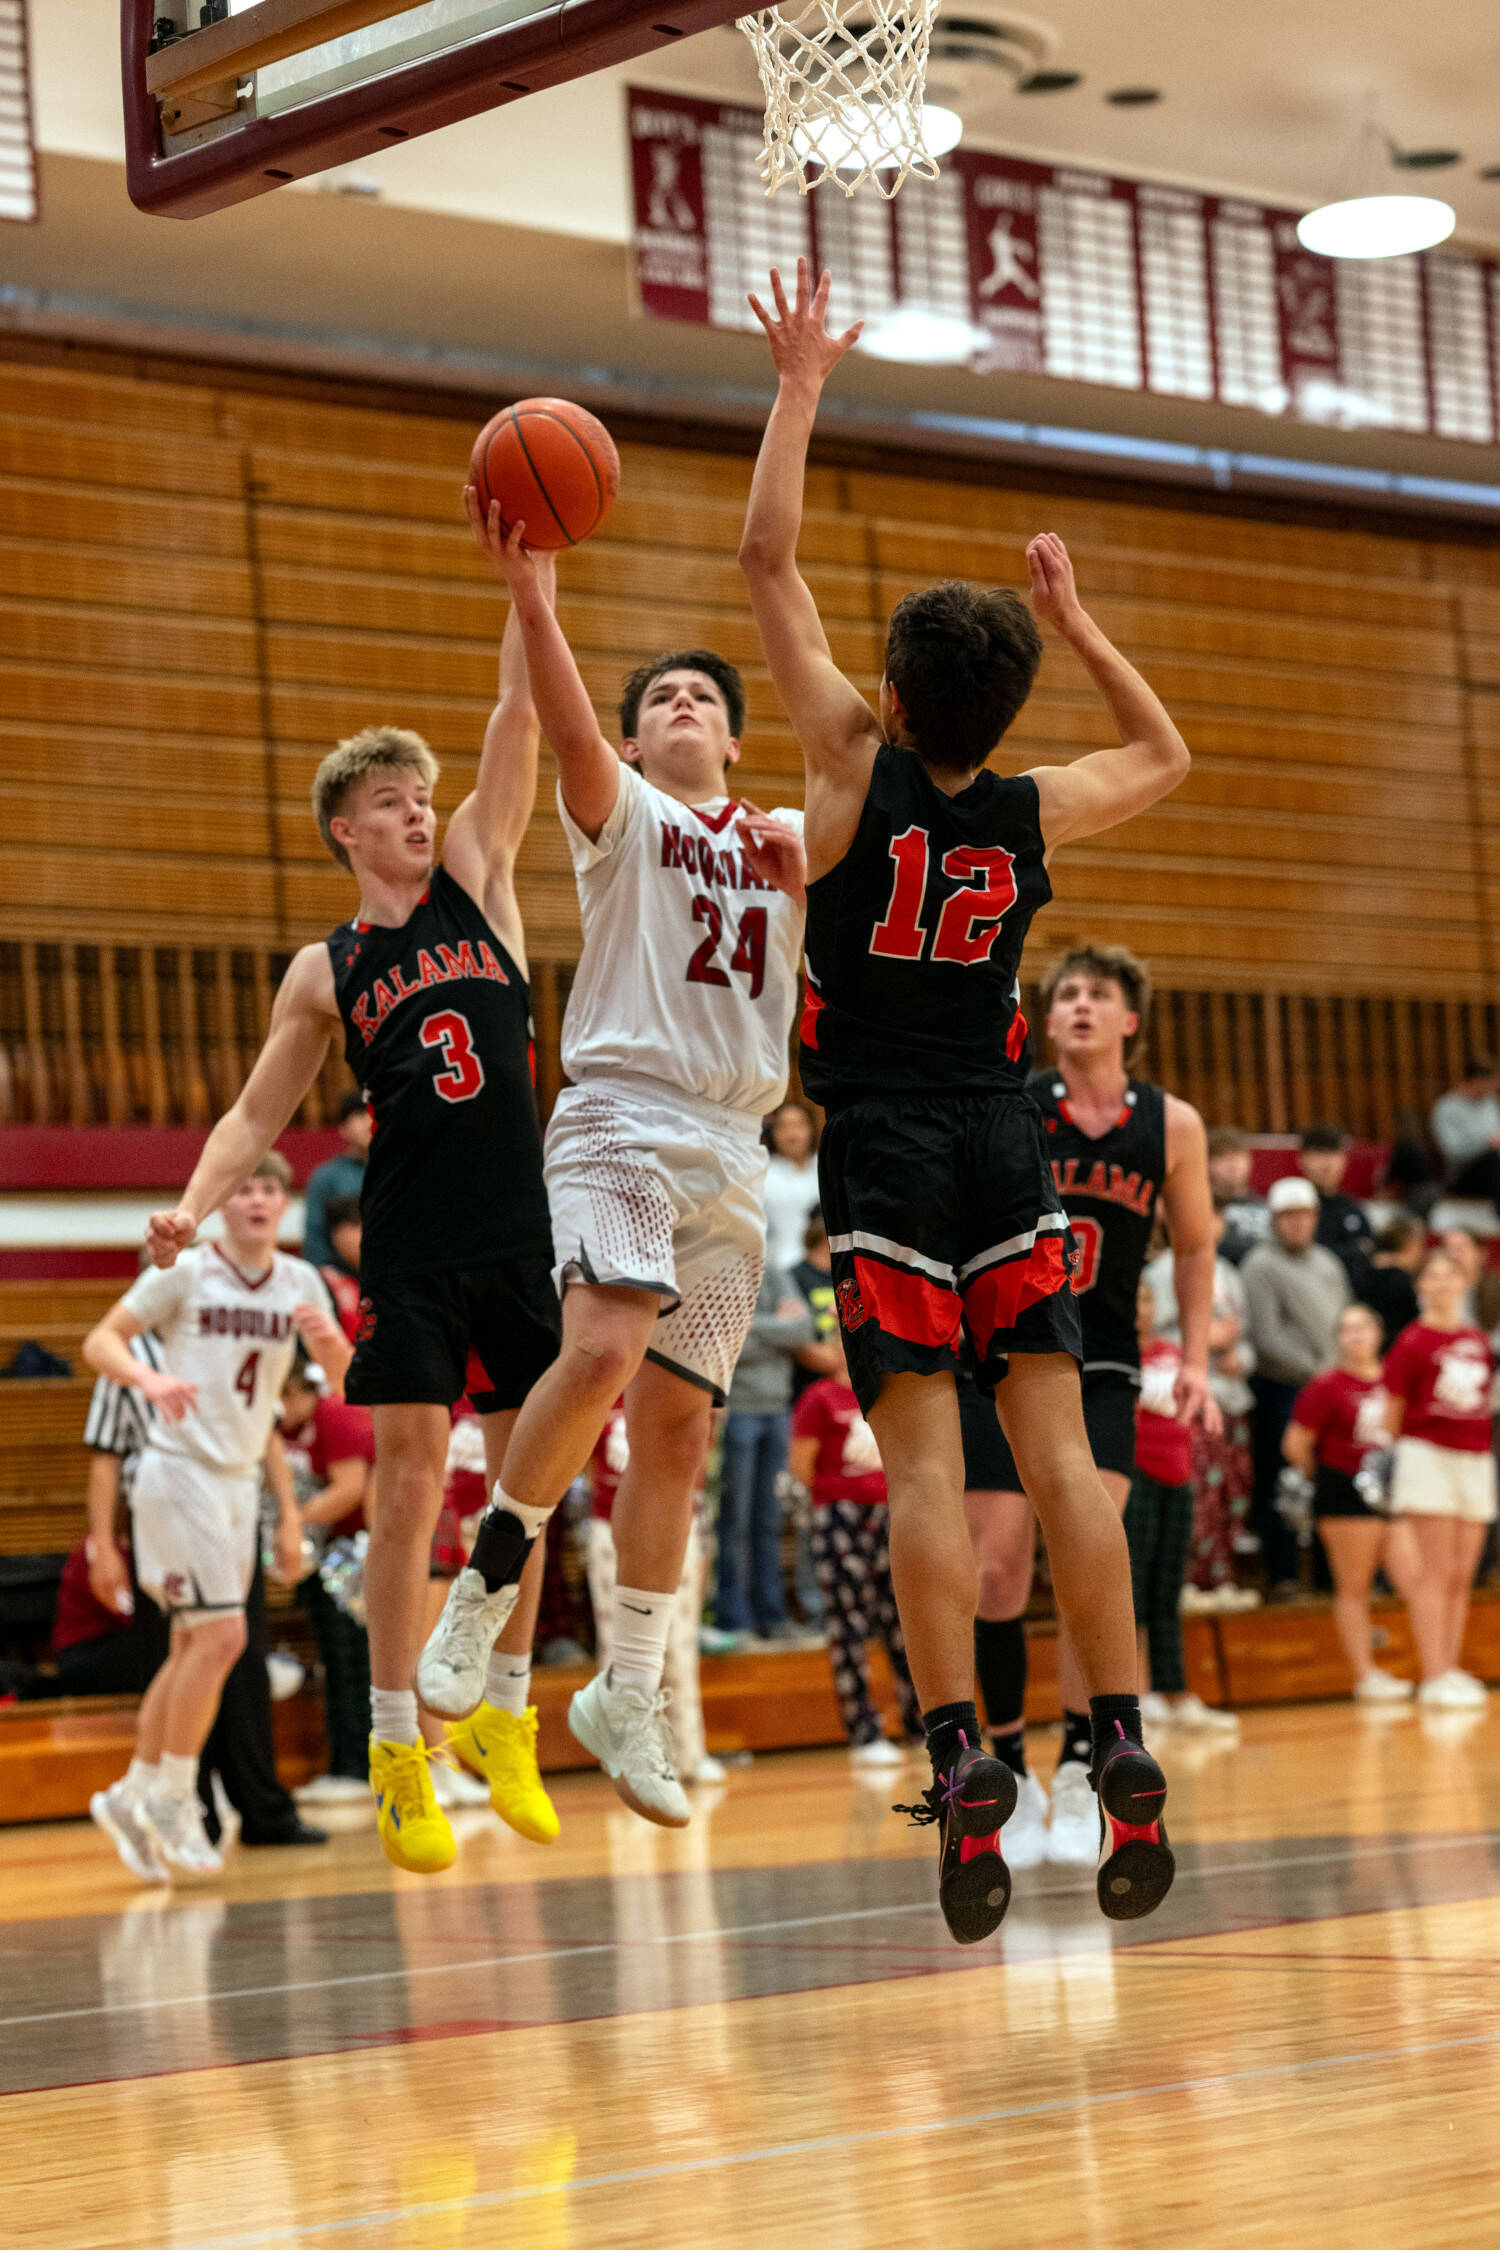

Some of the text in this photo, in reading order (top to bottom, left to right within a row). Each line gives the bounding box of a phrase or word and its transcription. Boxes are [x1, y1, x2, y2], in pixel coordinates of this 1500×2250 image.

[660, 820, 779, 892] HOQUIA
[868, 824, 1018, 966] 12
[351, 940, 511, 1046] KALAMA
[685, 894, 768, 1001] 24
[418, 1008, 486, 1104] 3
[234, 1350, 262, 1410] 4
